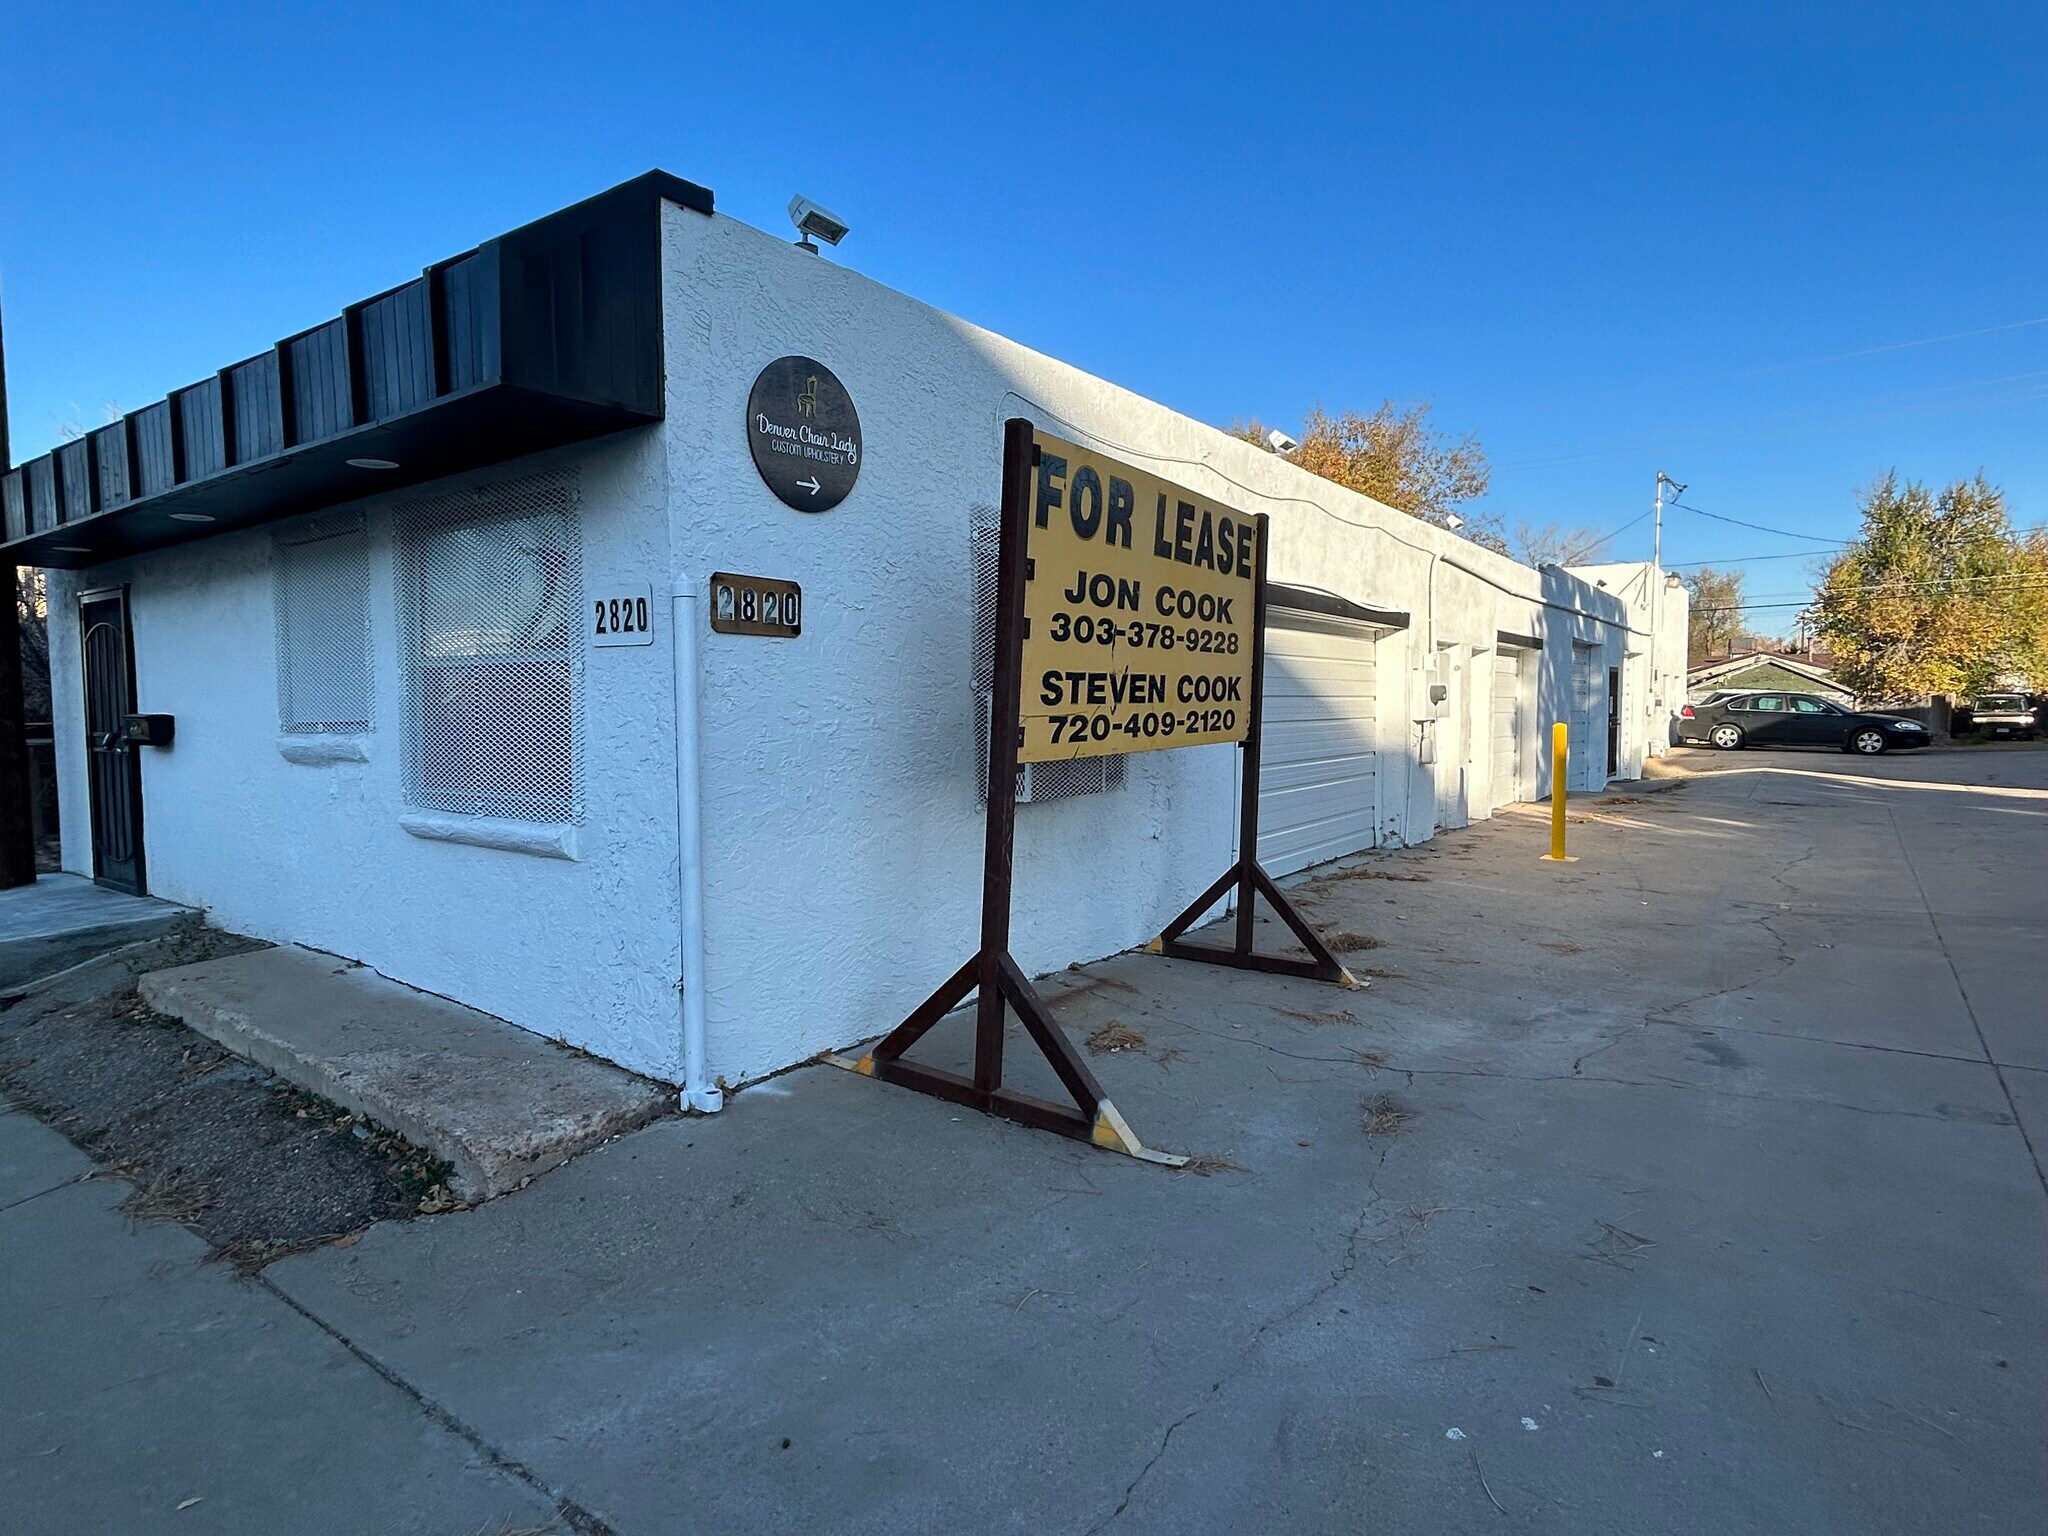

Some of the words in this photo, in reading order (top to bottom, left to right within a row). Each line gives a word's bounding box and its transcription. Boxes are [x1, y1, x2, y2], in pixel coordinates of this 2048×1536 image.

[756, 413, 797, 438] Denver
[800, 425, 829, 447] Chair
[831, 433, 857, 464] Lady
[771, 439, 801, 456] CUSTOM
[803, 447, 844, 465] UPHOLSTERY
[1035, 451, 1135, 550] FOR
[1153, 492, 1252, 580] LEASE
[595, 597, 648, 634] 2820
[718, 585, 799, 626] 2820
[1064, 571, 1140, 612] JON
[1155, 586, 1234, 624] COOK
[1050, 613, 1240, 655] 303-378-9228
[1040, 669, 1166, 707] STEVEN
[1177, 674, 1242, 703] COOK
[1048, 709, 1236, 745] 720-409-2120
